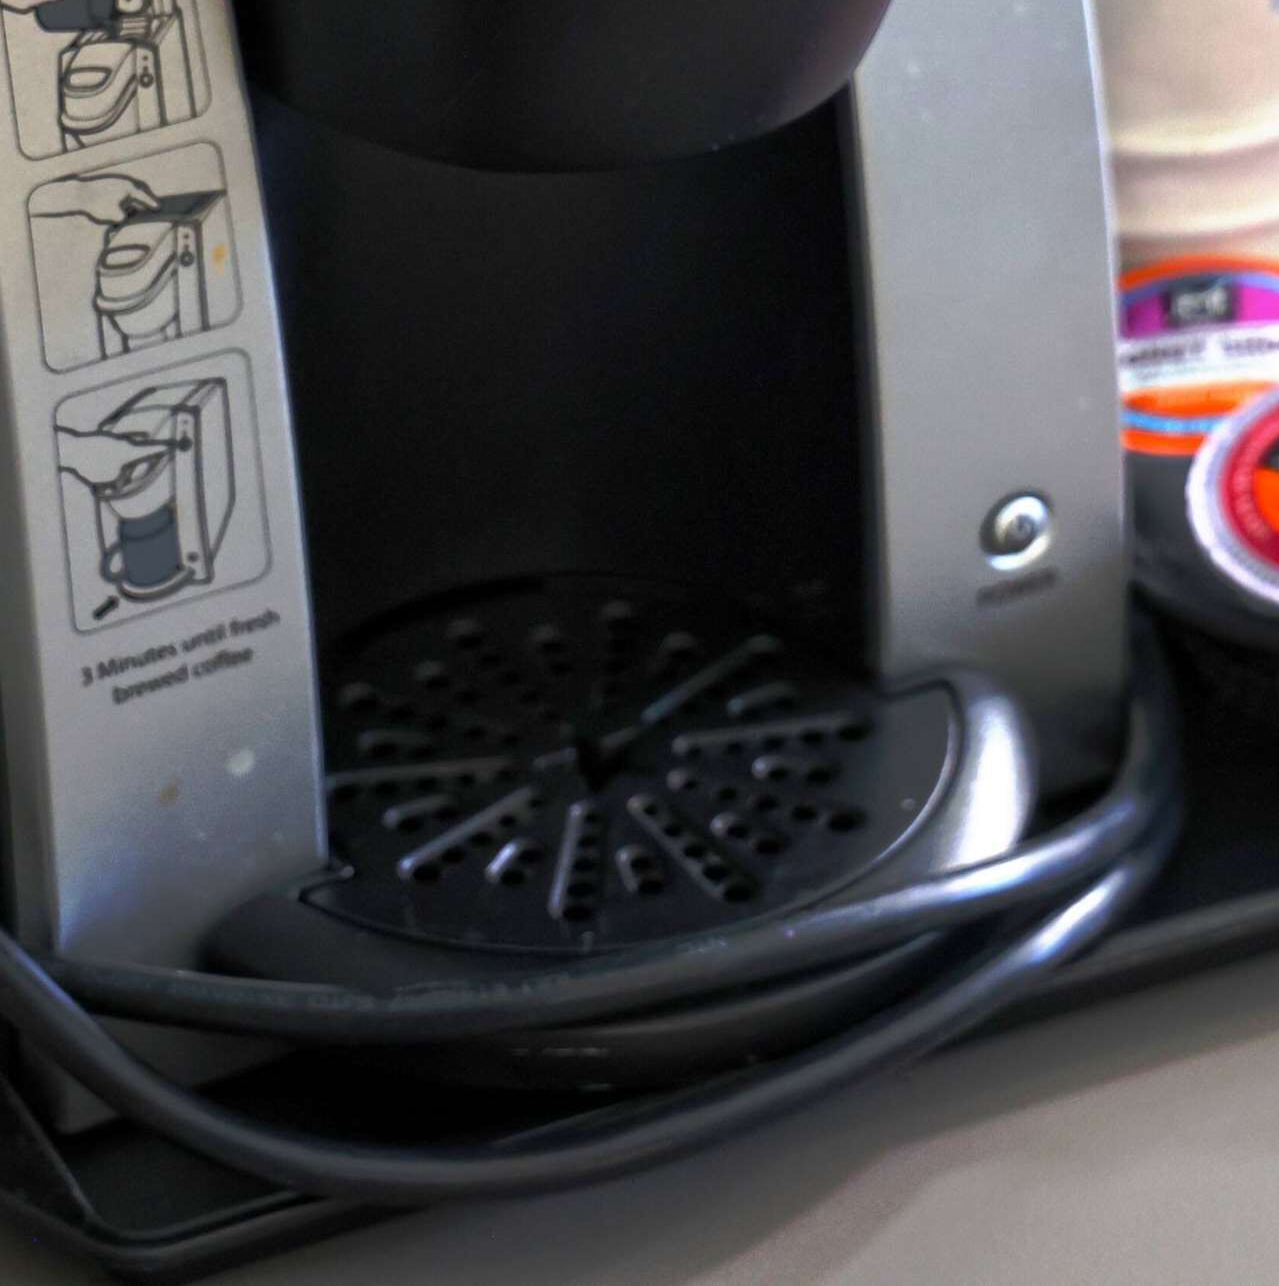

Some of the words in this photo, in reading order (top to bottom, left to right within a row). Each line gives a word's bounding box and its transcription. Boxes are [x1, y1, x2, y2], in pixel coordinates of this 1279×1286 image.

[81, 666, 93, 687] 3
[97, 644, 177, 679] Minutes
[182, 624, 227, 652] until
[230, 609, 280, 635] fresh
[112, 665, 188, 704] brewed
[192, 648, 253, 677] coffee
